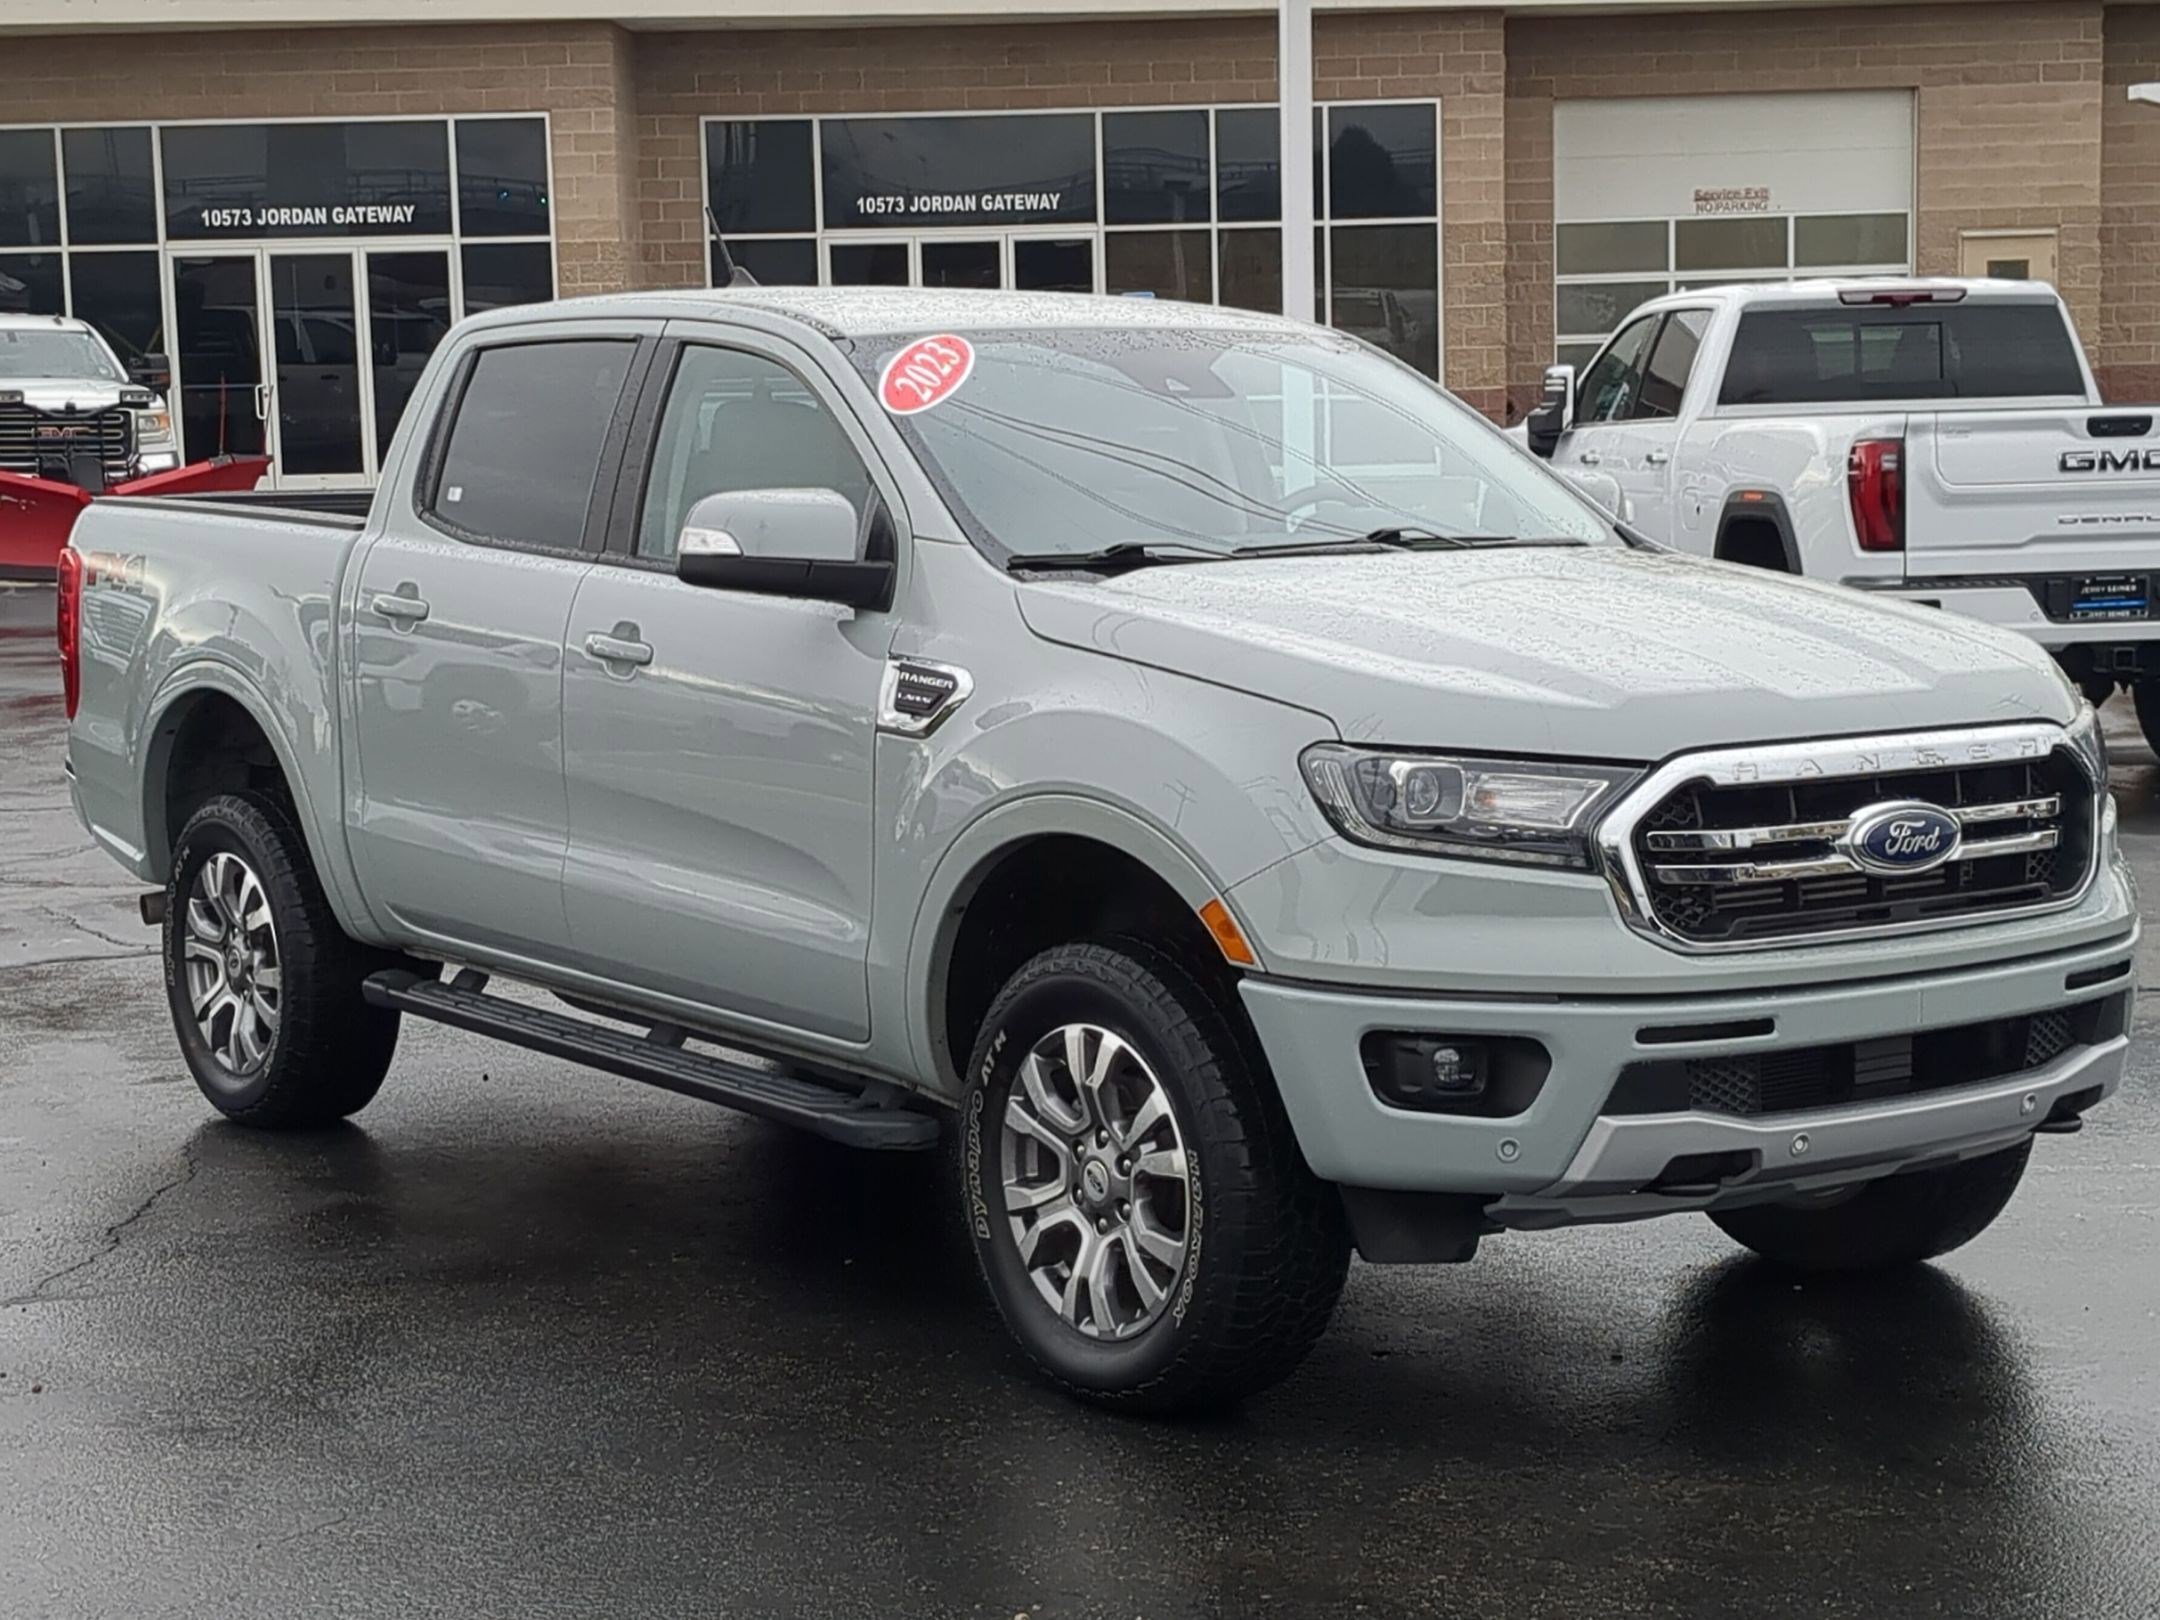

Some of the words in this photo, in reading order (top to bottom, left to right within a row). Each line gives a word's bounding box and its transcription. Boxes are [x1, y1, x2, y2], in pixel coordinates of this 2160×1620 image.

[856, 196, 905, 214] 10573
[909, 195, 977, 213] JORDAN
[981, 193, 1061, 211] GATEWAY
[1696, 202, 1713, 214] NO
[1715, 201, 1768, 212] PARKING
[201, 208, 252, 227] 10573
[257, 207, 327, 226] JORDAN
[331, 205, 416, 224] GATEWAY
[895, 341, 960, 403] 2023
[900, 671, 954, 690] RANGER
[1885, 820, 1941, 856] Ford
